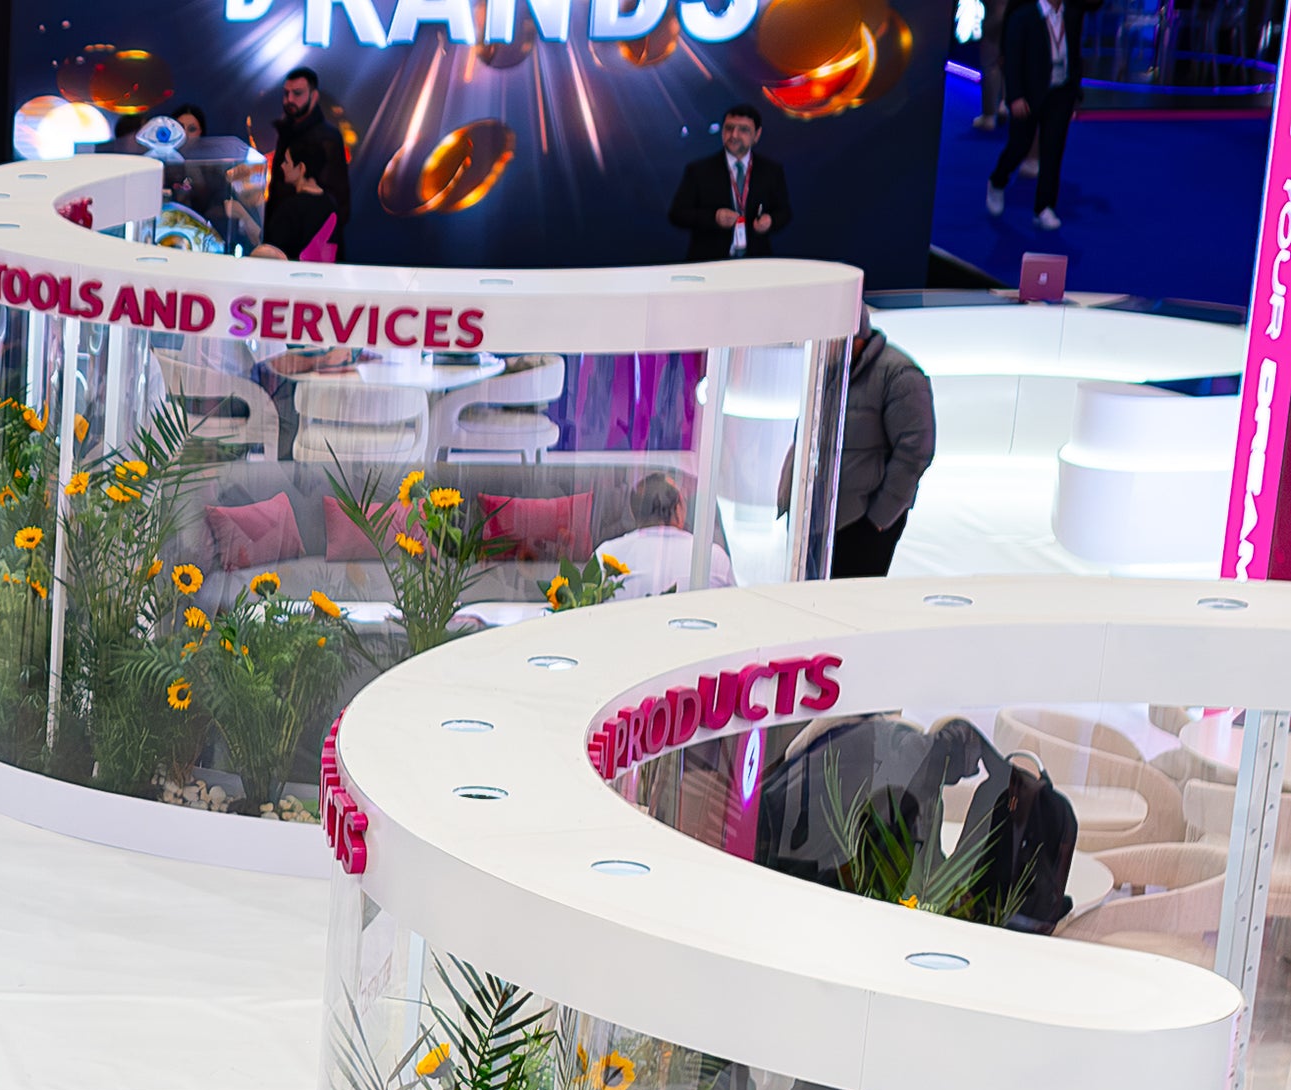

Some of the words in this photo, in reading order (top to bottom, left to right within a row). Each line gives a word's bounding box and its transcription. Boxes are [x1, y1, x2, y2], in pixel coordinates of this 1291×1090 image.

[109, 284, 216, 333] AND
[227, 295, 486, 349] SERVICES
[602, 652, 843, 779] PRODUCTS
